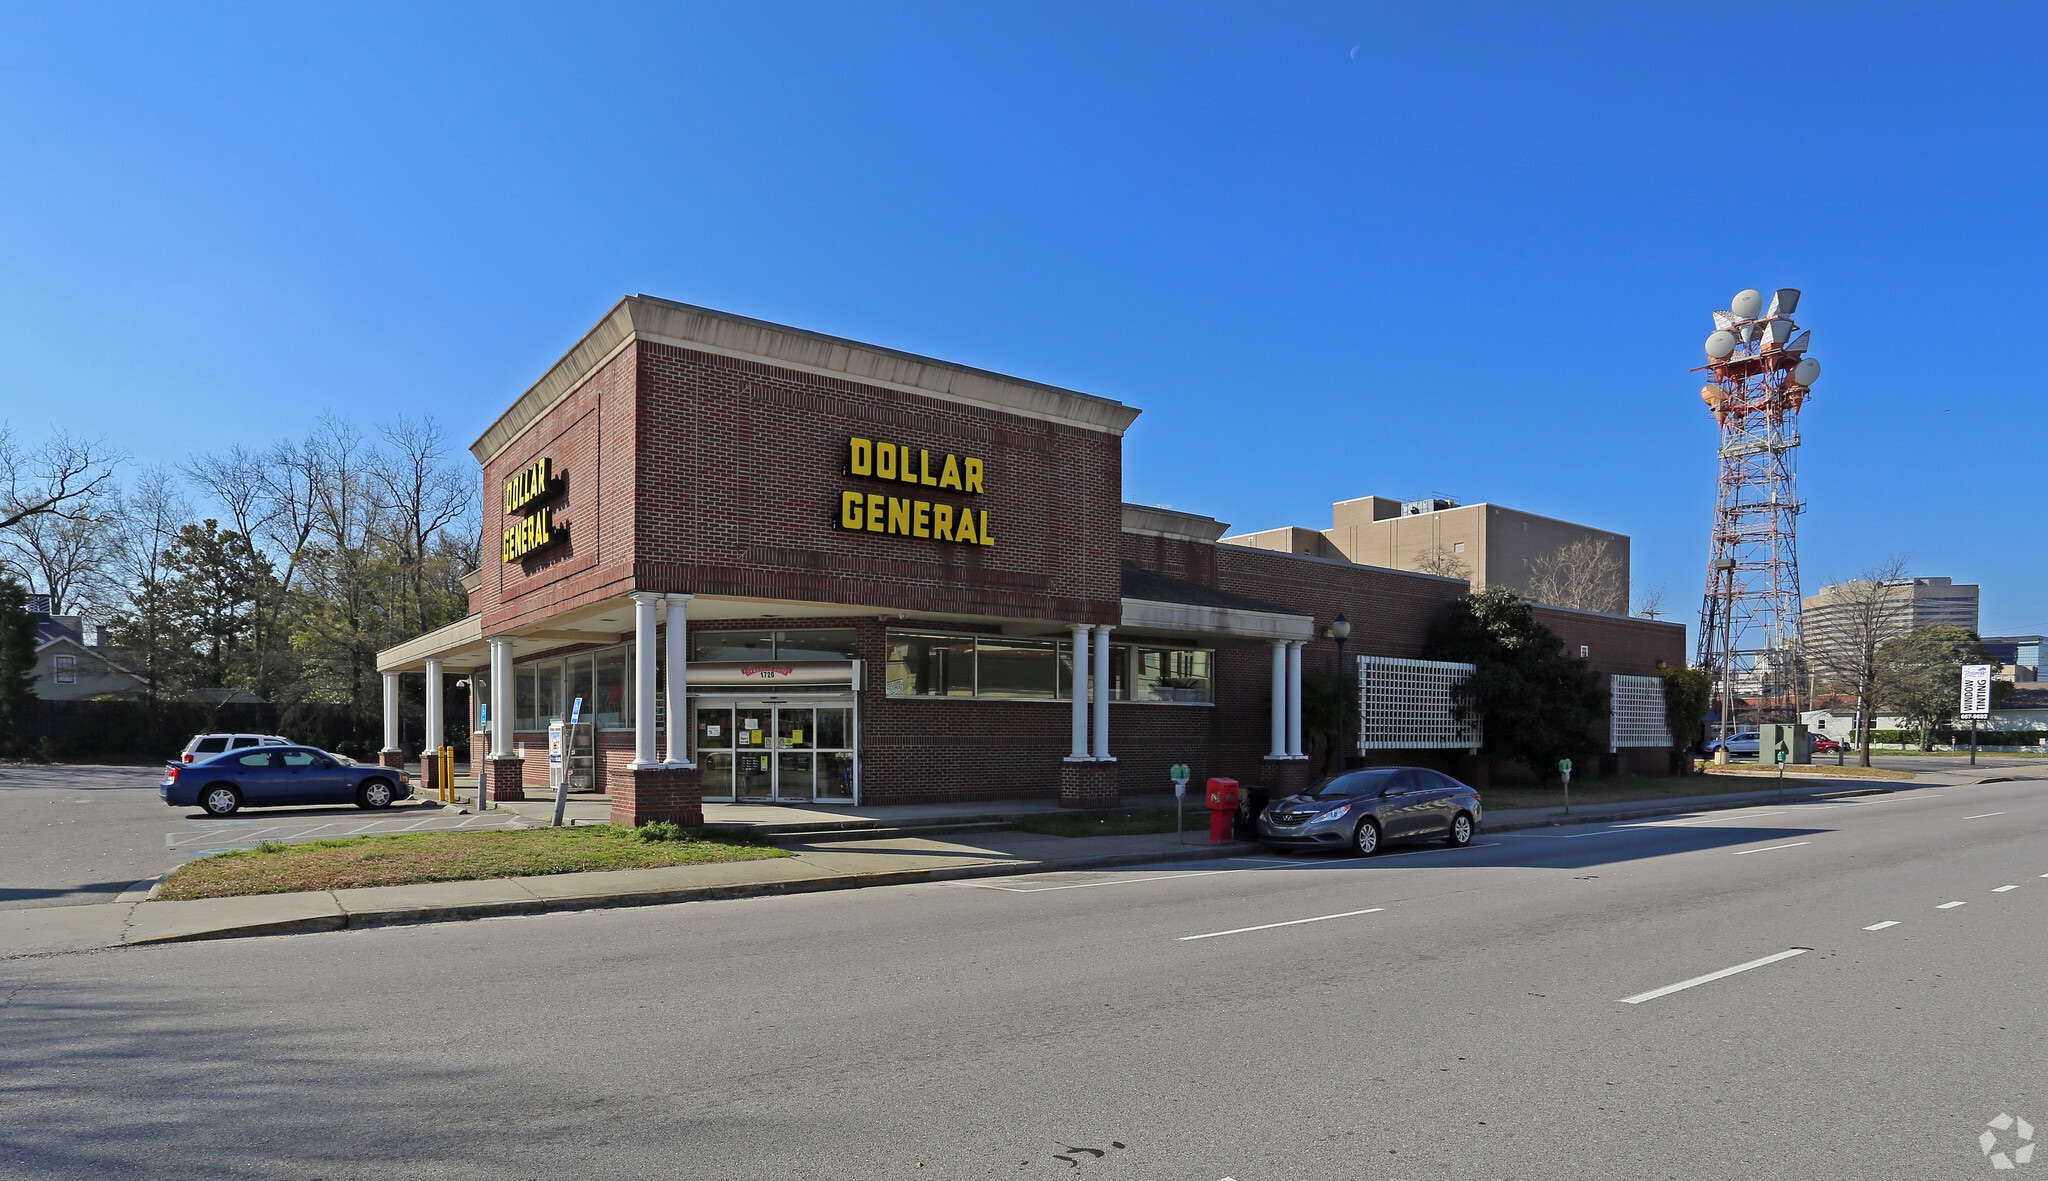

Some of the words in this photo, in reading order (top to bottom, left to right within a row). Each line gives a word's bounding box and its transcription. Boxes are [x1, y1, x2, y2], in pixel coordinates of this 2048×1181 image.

[506, 457, 546, 515] DOLLAR
[850, 437, 984, 494] DOLLAR
[503, 507, 549, 563] GENERAL
[842, 491, 995, 546] GENERAL
[1963, 679, 1974, 711] WINDOW
[1976, 679, 1987, 711] TINTING
